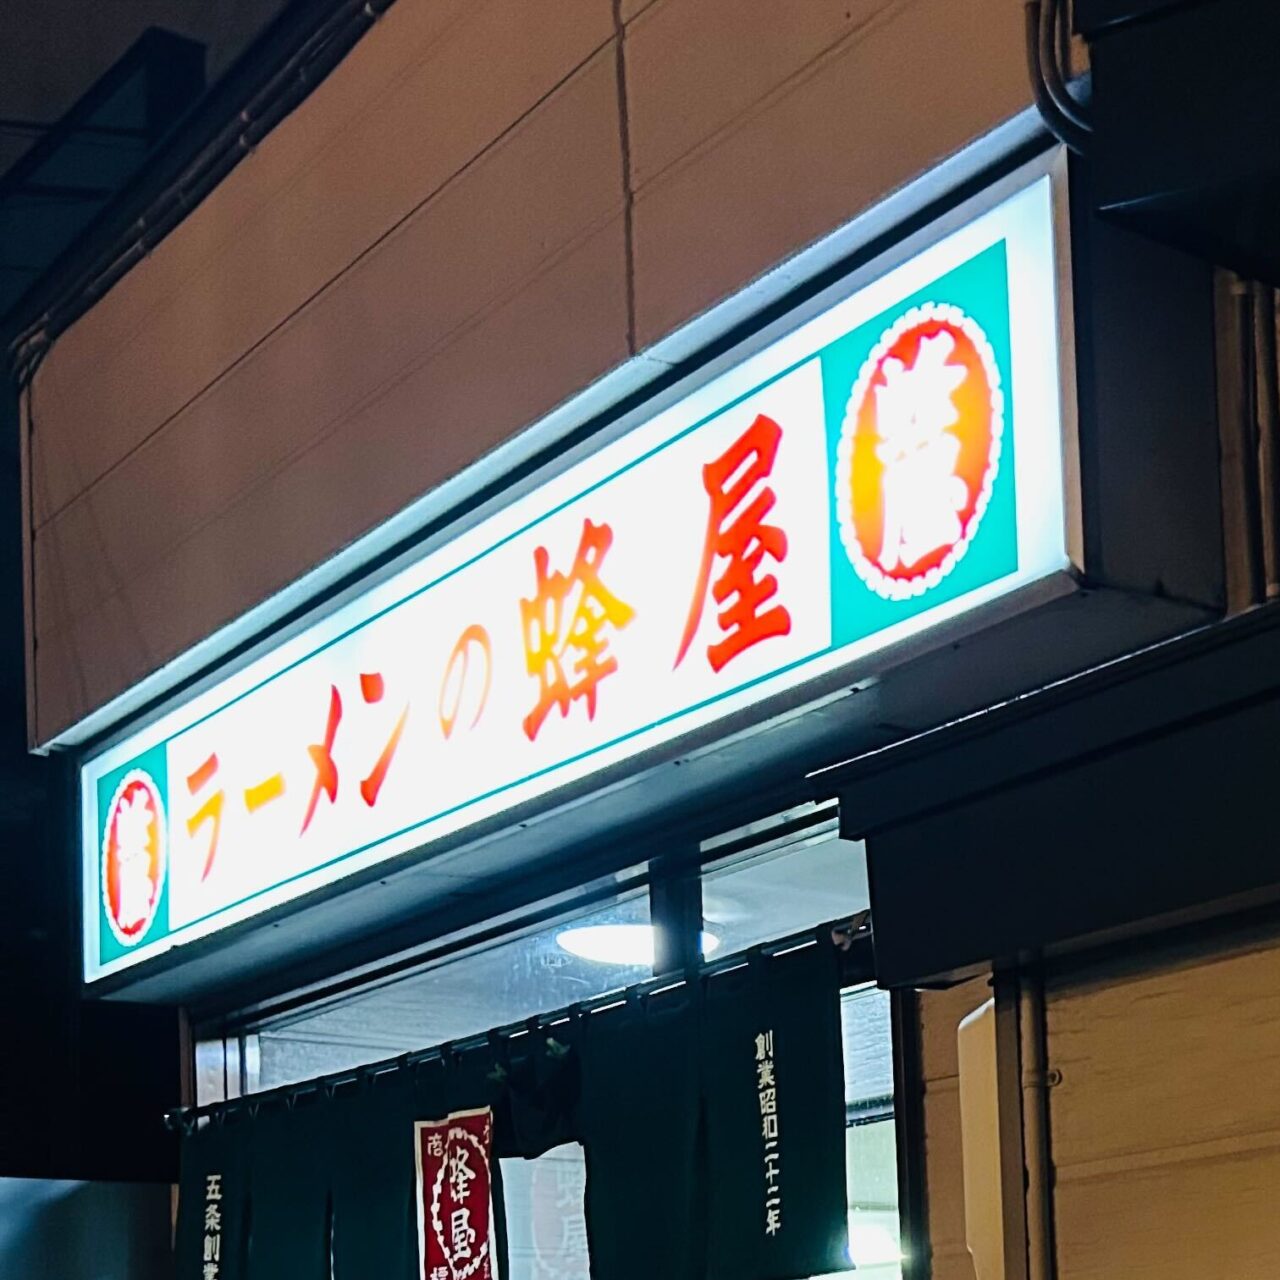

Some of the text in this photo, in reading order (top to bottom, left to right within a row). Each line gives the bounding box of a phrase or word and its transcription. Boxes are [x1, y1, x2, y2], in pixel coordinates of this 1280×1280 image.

[186, 413, 791, 883] ラーメンの蜂屋
[449, 1145, 477, 1262] 蜂屋
[754, 1029, 782, 1237] 創業昭和二十二年
